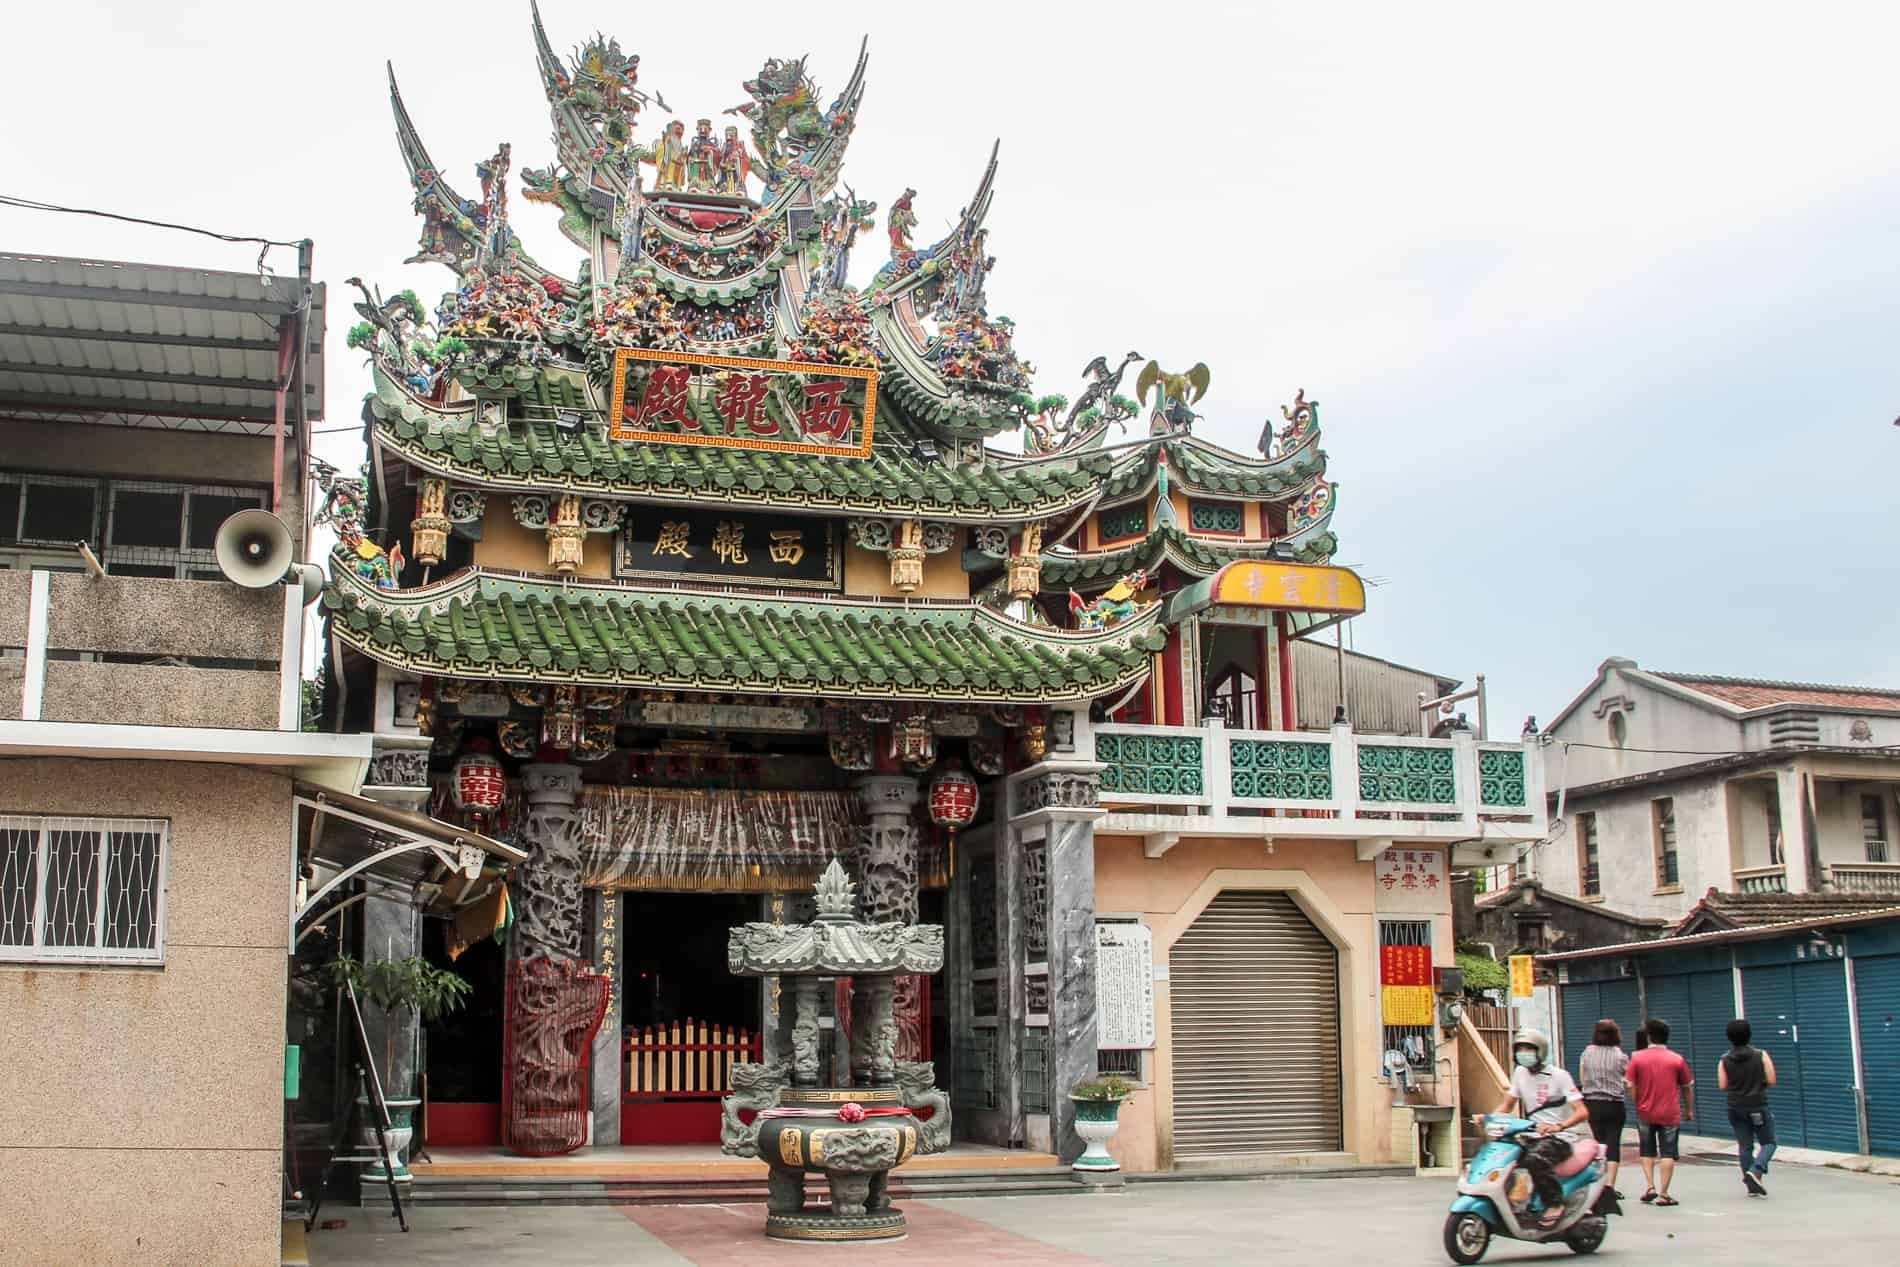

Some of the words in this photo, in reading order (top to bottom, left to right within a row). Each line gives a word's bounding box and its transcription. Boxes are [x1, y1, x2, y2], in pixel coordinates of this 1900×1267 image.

[634, 364, 853, 440] 西龍殿
[652, 520, 805, 566] 西龍殿
